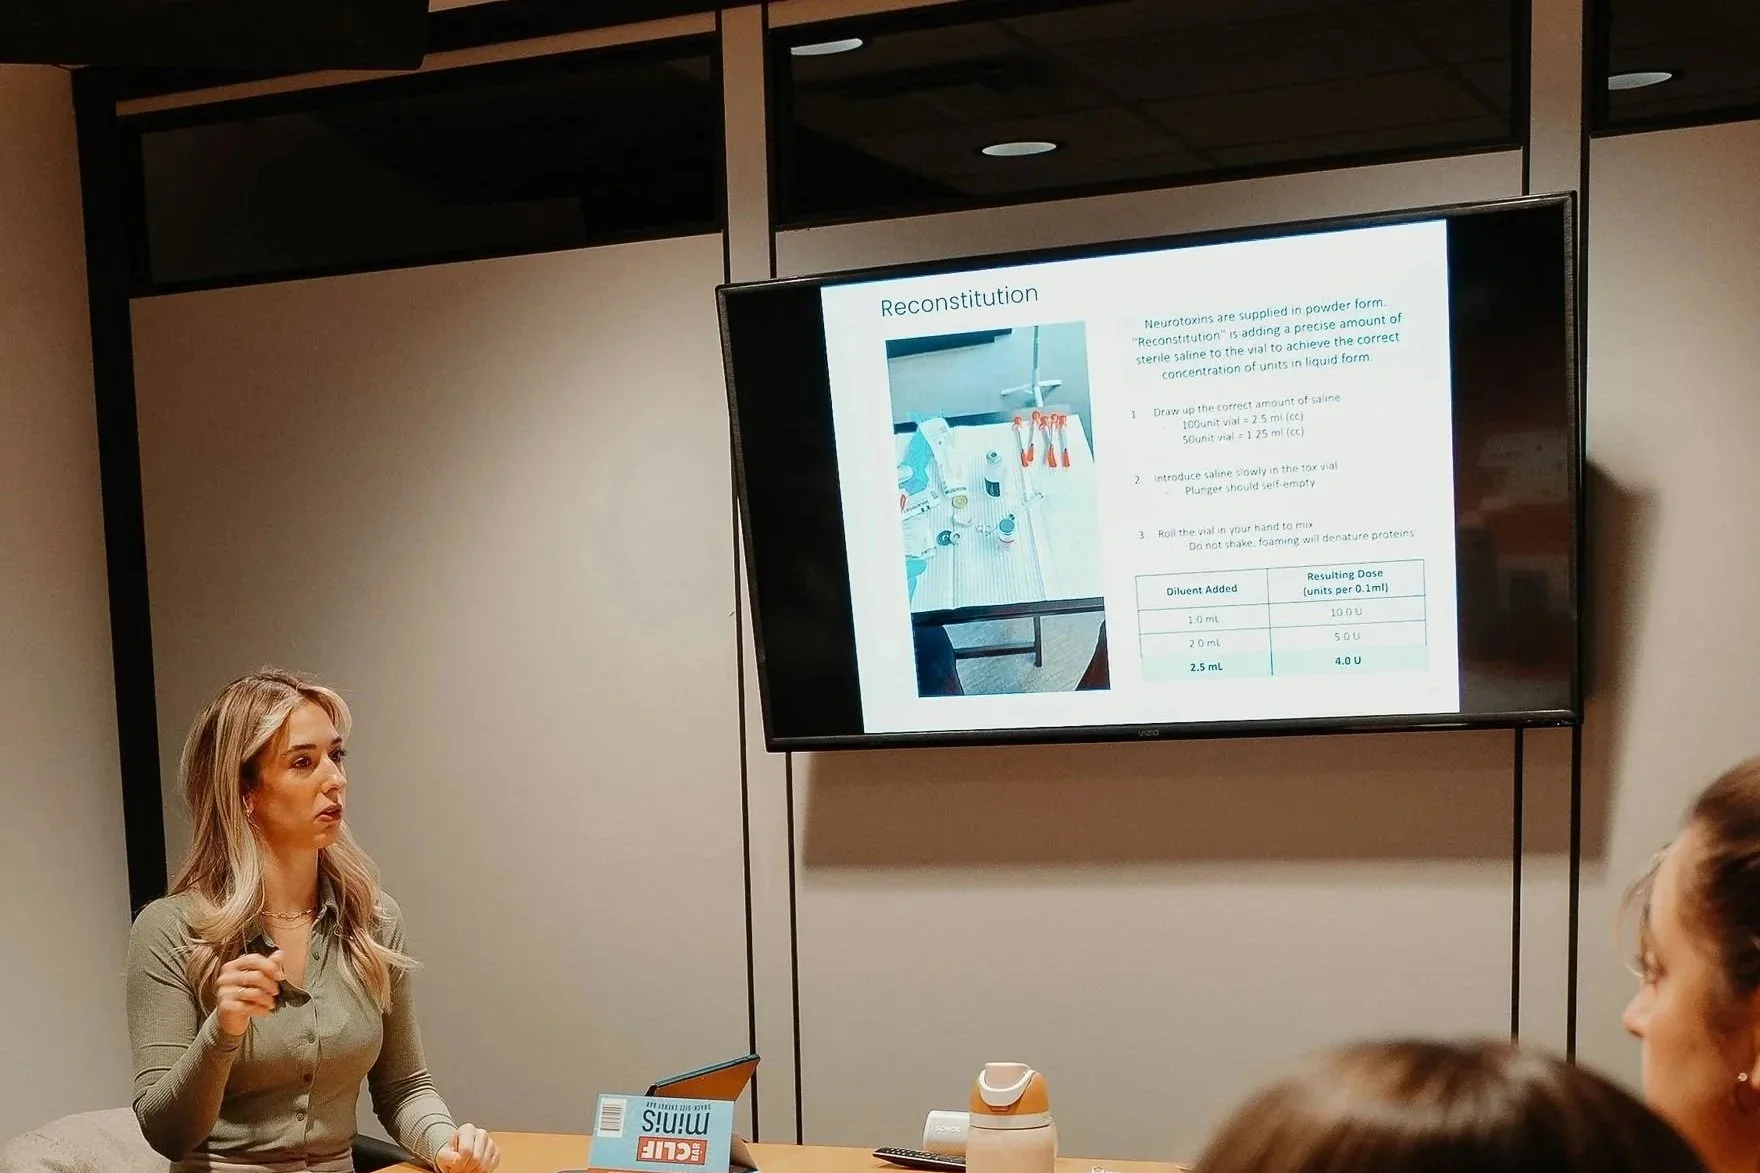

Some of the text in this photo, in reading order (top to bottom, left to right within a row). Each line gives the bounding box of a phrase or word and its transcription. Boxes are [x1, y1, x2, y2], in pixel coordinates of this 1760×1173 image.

[880, 285, 1038, 317] Reconstitution
[1144, 315, 1214, 329] Neurotoxins
[1217, 313, 1235, 323] are
[1239, 306, 1288, 321] supplied
[1291, 305, 1302, 315] in
[1305, 300, 1351, 316] powder
[1229, 330, 1238, 339] is
[1241, 325, 1281, 338] adding
[1284, 326, 1290, 335] a
[1294, 320, 1336, 334] precise
[1339, 316, 1386, 329] amount
[1389, 312, 1402, 325] of
[1136, 332, 1400, 366] sterile saline to the vial to achieve the correct
[1161, 364, 1241, 380] concentration
[1244, 361, 1256, 373] of
[1259, 359, 1288, 371] units
[1291, 358, 1302, 369] in
[1305, 355, 1338, 370] liquid
[1153, 407, 1180, 417] Draw
[1182, 407, 1195, 417] up
[1197, 404, 1214, 414] the
[1217, 402, 1253, 412] correct
[1255, 397, 1295, 409] amount
[1297, 395, 1308, 405] of
[1311, 393, 1341, 404] saline
[1223, 416, 1240, 427] vial
[1286, 411, 1304, 422] (cc)
[1218, 431, 1234, 442] vial
[1286, 427, 1304, 438] (cc)
[1154, 471, 1201, 483] Introduce
[1204, 468, 1232, 480] saline
[1235, 466, 1267, 479] slowly
[1269, 466, 1279, 474] in
[1281, 464, 1298, 473] the
[1301, 463, 1317, 472] tox
[1320, 461, 1338, 471] vial
[1185, 479, 1315, 496] Plunger should self-empty
[1158, 528, 1176, 538] Roll
[1179, 527, 1195, 537] the
[1198, 526, 1215, 536] vial
[1217, 525, 1226, 534] in
[1229, 524, 1251, 536] your
[1254, 522, 1279, 532] hand
[1282, 521, 1293, 530] to
[1295, 519, 1313, 529] mix
[1189, 541, 1202, 551] Do
[1205, 540, 1222, 549] not
[1258, 535, 1300, 548] foaming
[1303, 533, 1320, 543] will
[1322, 530, 1369, 543] denature
[1371, 528, 1415, 541] proteins
[1307, 568, 1384, 582] Resulting Dose
[1166, 584, 1238, 596] Diluent Added
[1303, 582, 1389, 597] (units per 0.1ml)
[1355, 607, 1363, 616] U
[1353, 631, 1361, 640] U
[1190, 661, 1223, 672] 2.5 mL
[1335, 656, 1362, 666] 4.0 U
[641, 1109, 710, 1135] minis
[641, 1140, 701, 1162] BAR CLIF
